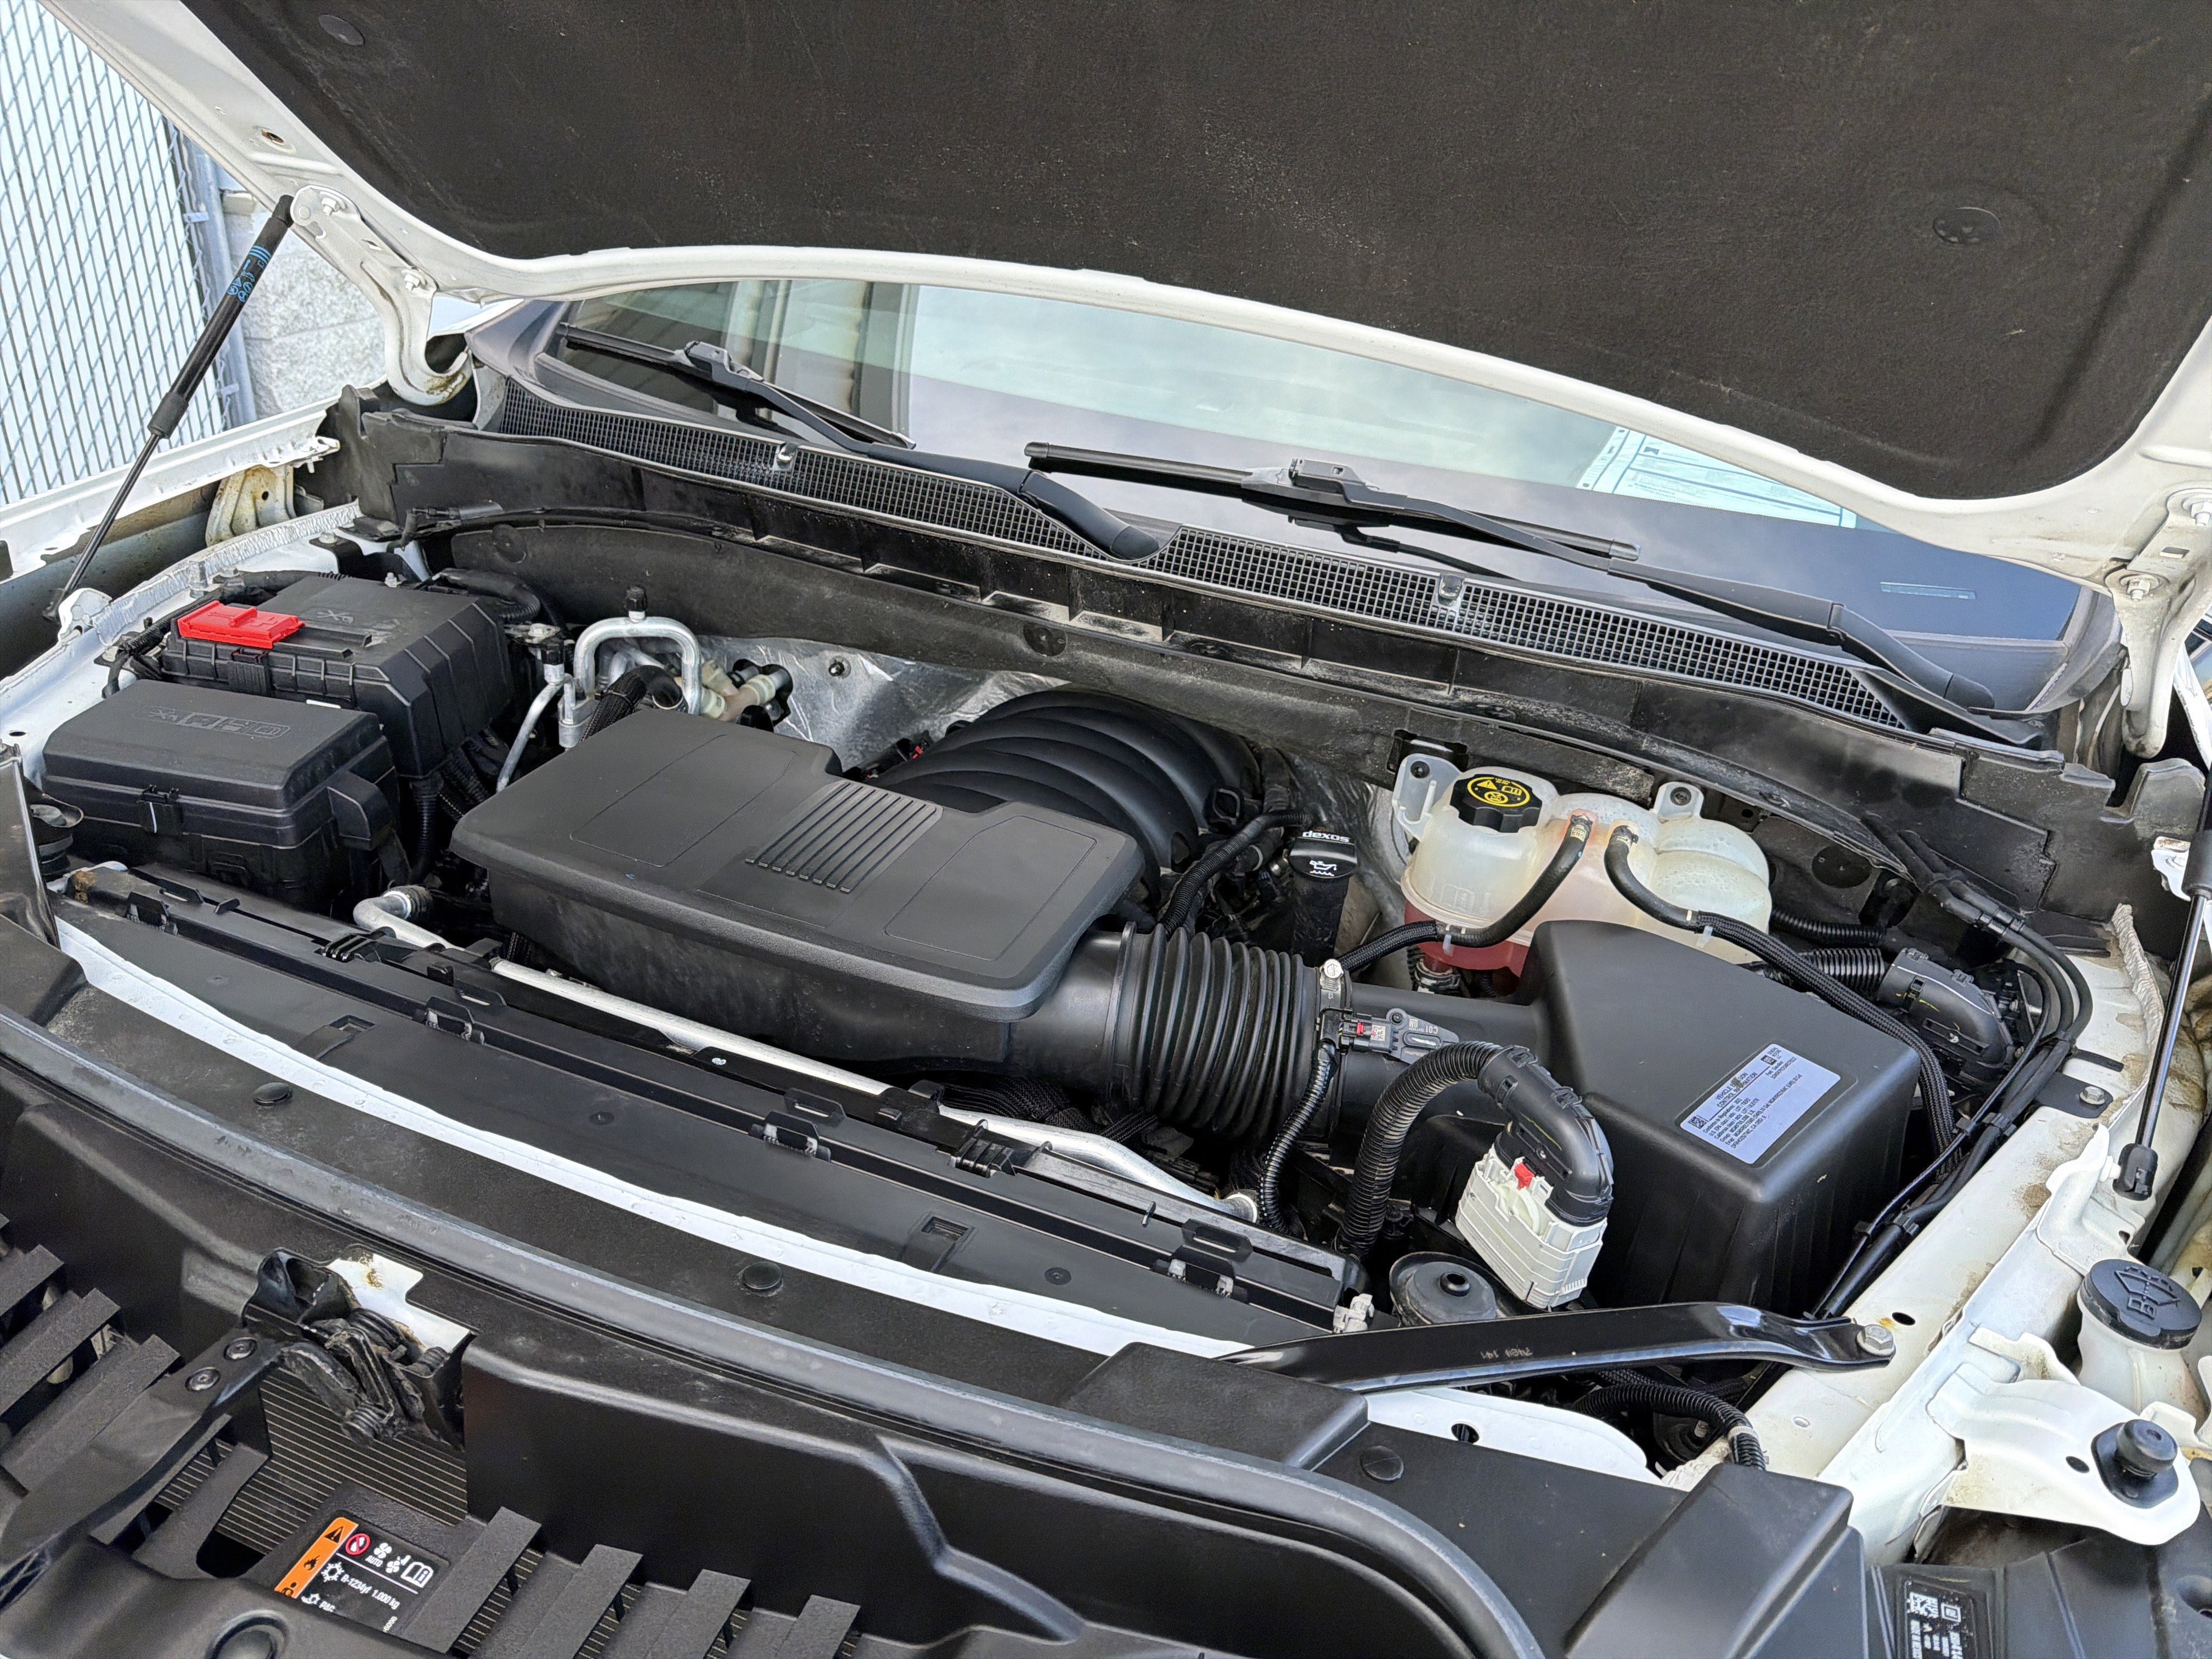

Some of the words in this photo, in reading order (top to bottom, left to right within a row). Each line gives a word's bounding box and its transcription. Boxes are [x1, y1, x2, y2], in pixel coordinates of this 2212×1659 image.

[1302, 831, 1350, 843] dexos
[1715, 1086, 1733, 1100] VEHICLE
[1717, 1092, 1736, 1108] CONTROL
[365, 1555, 383, 1567] AUTO
[341, 1574, 373, 1594] R-1234yf
[373, 1589, 391, 1604] 1.000
[388, 1598, 400, 1610] kg
